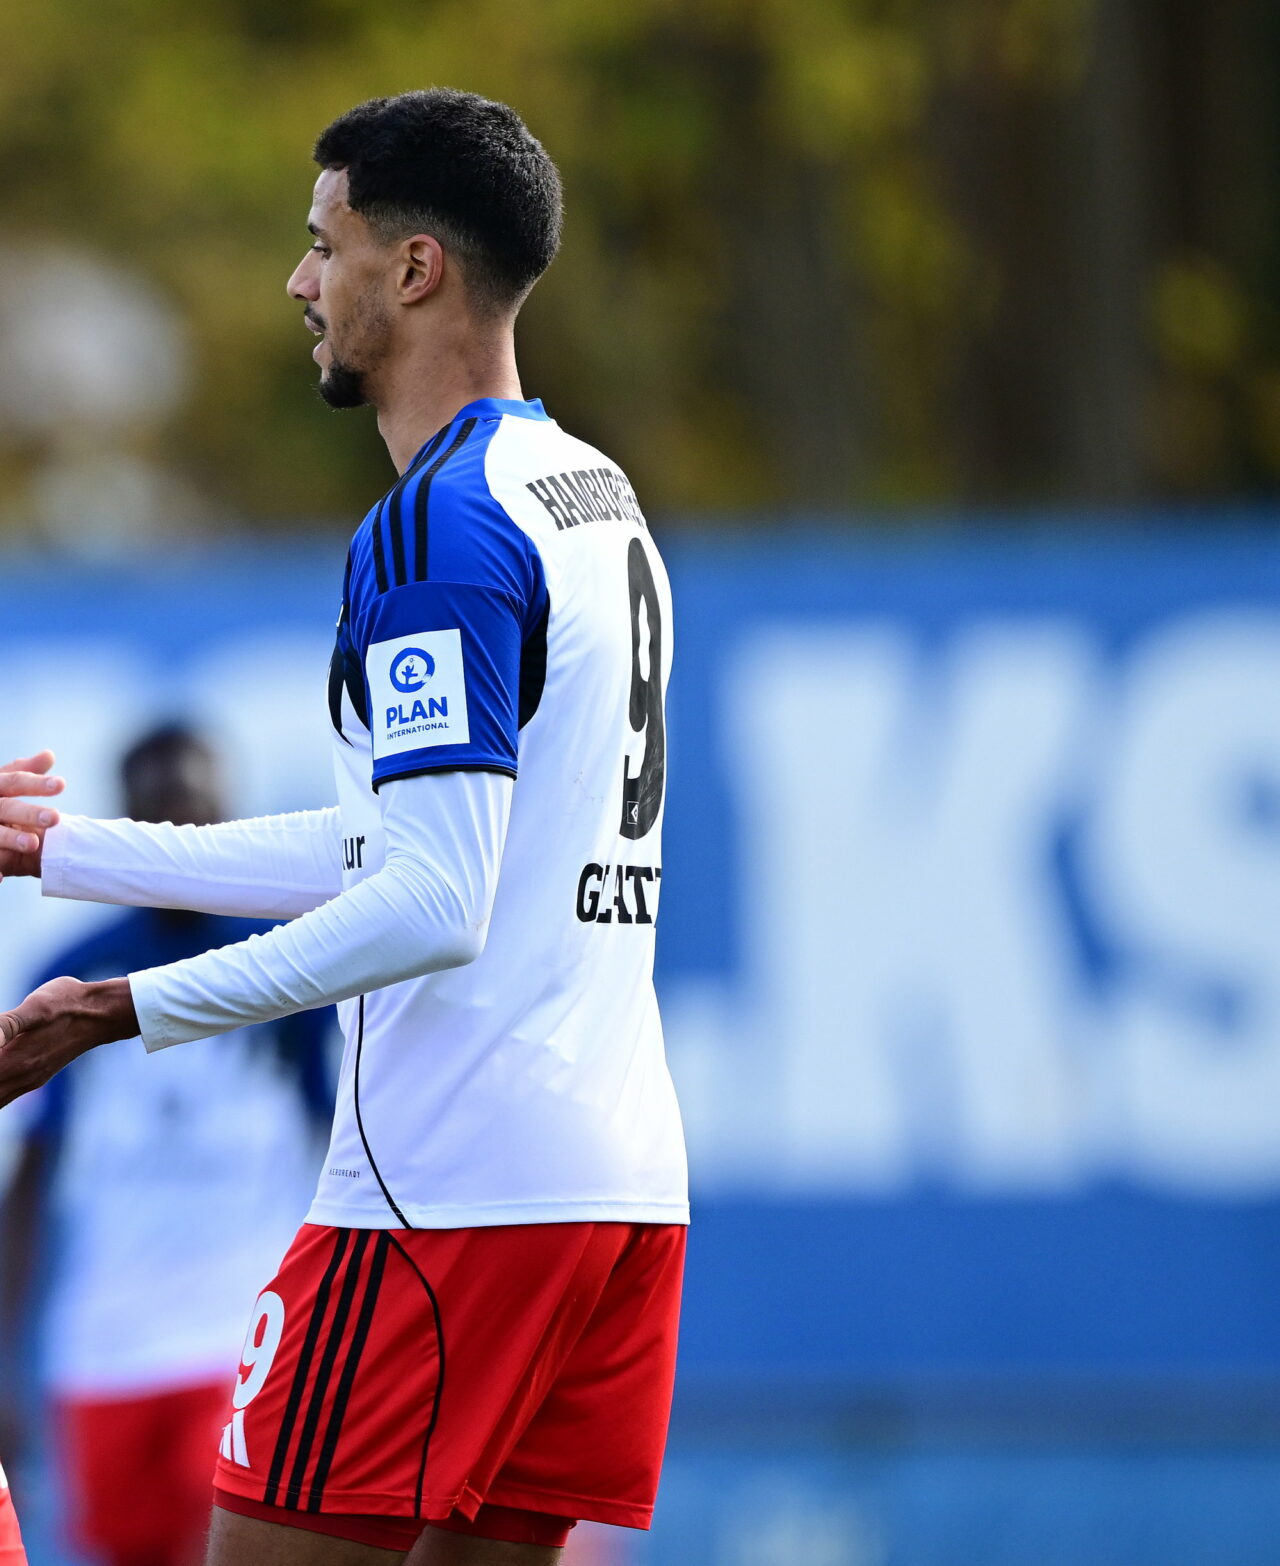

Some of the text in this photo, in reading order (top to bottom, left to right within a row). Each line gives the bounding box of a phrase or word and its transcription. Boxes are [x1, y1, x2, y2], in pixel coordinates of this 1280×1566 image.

[524, 467, 646, 531] HAMBUR
[386, 696, 449, 729] PLAN
[618, 536, 665, 841] 9
[386, 721, 451, 740] INTERNATIONAL
[232, 1290, 286, 1410] 9
